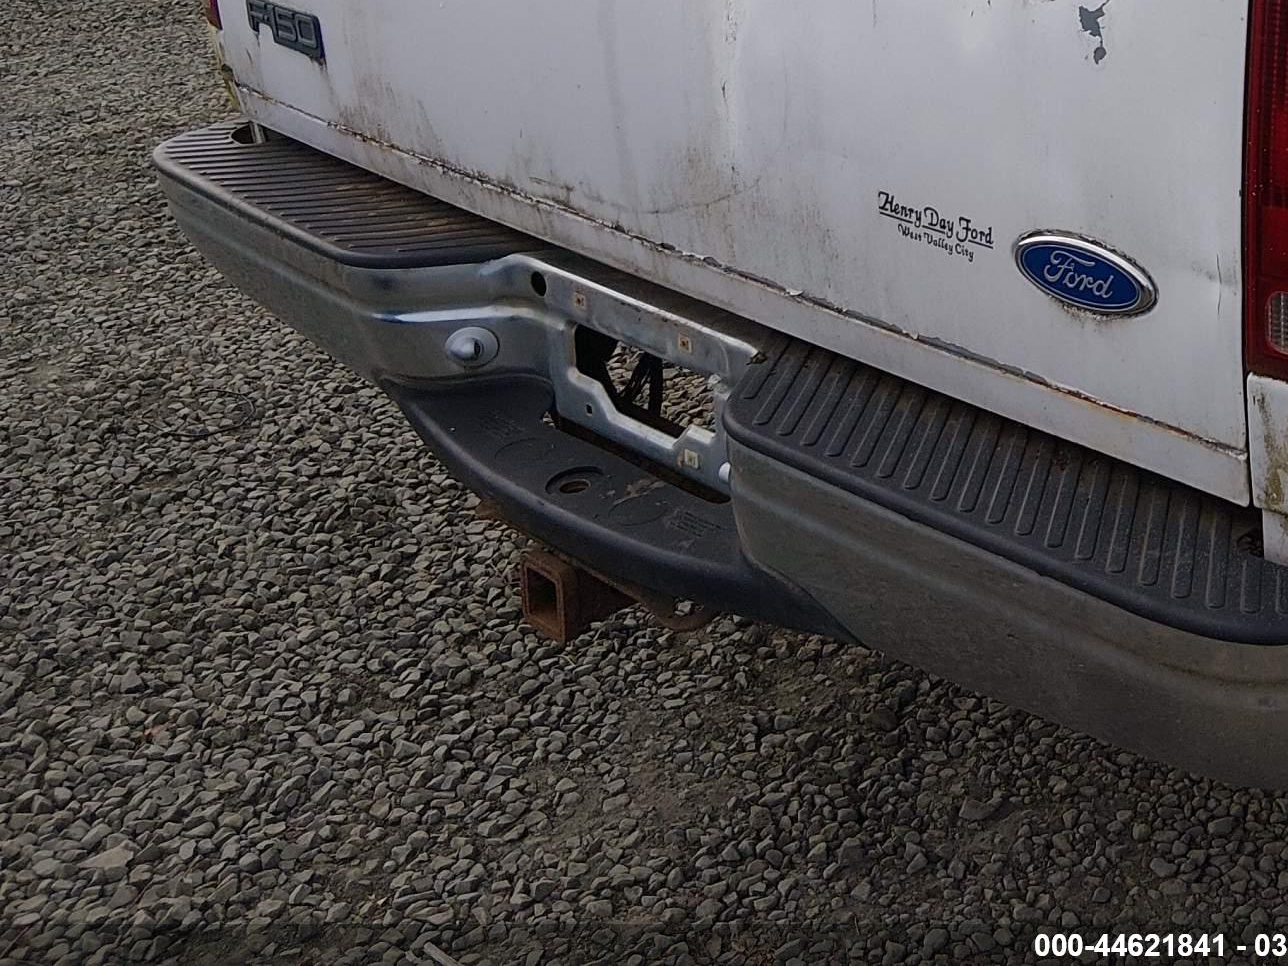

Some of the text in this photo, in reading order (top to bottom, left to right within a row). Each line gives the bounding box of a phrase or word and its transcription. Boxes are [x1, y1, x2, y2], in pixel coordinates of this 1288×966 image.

[878, 190, 994, 245] Henry Day Ford
[898, 223, 974, 263] West Valley City
[1043, 250, 1115, 299] Ford
